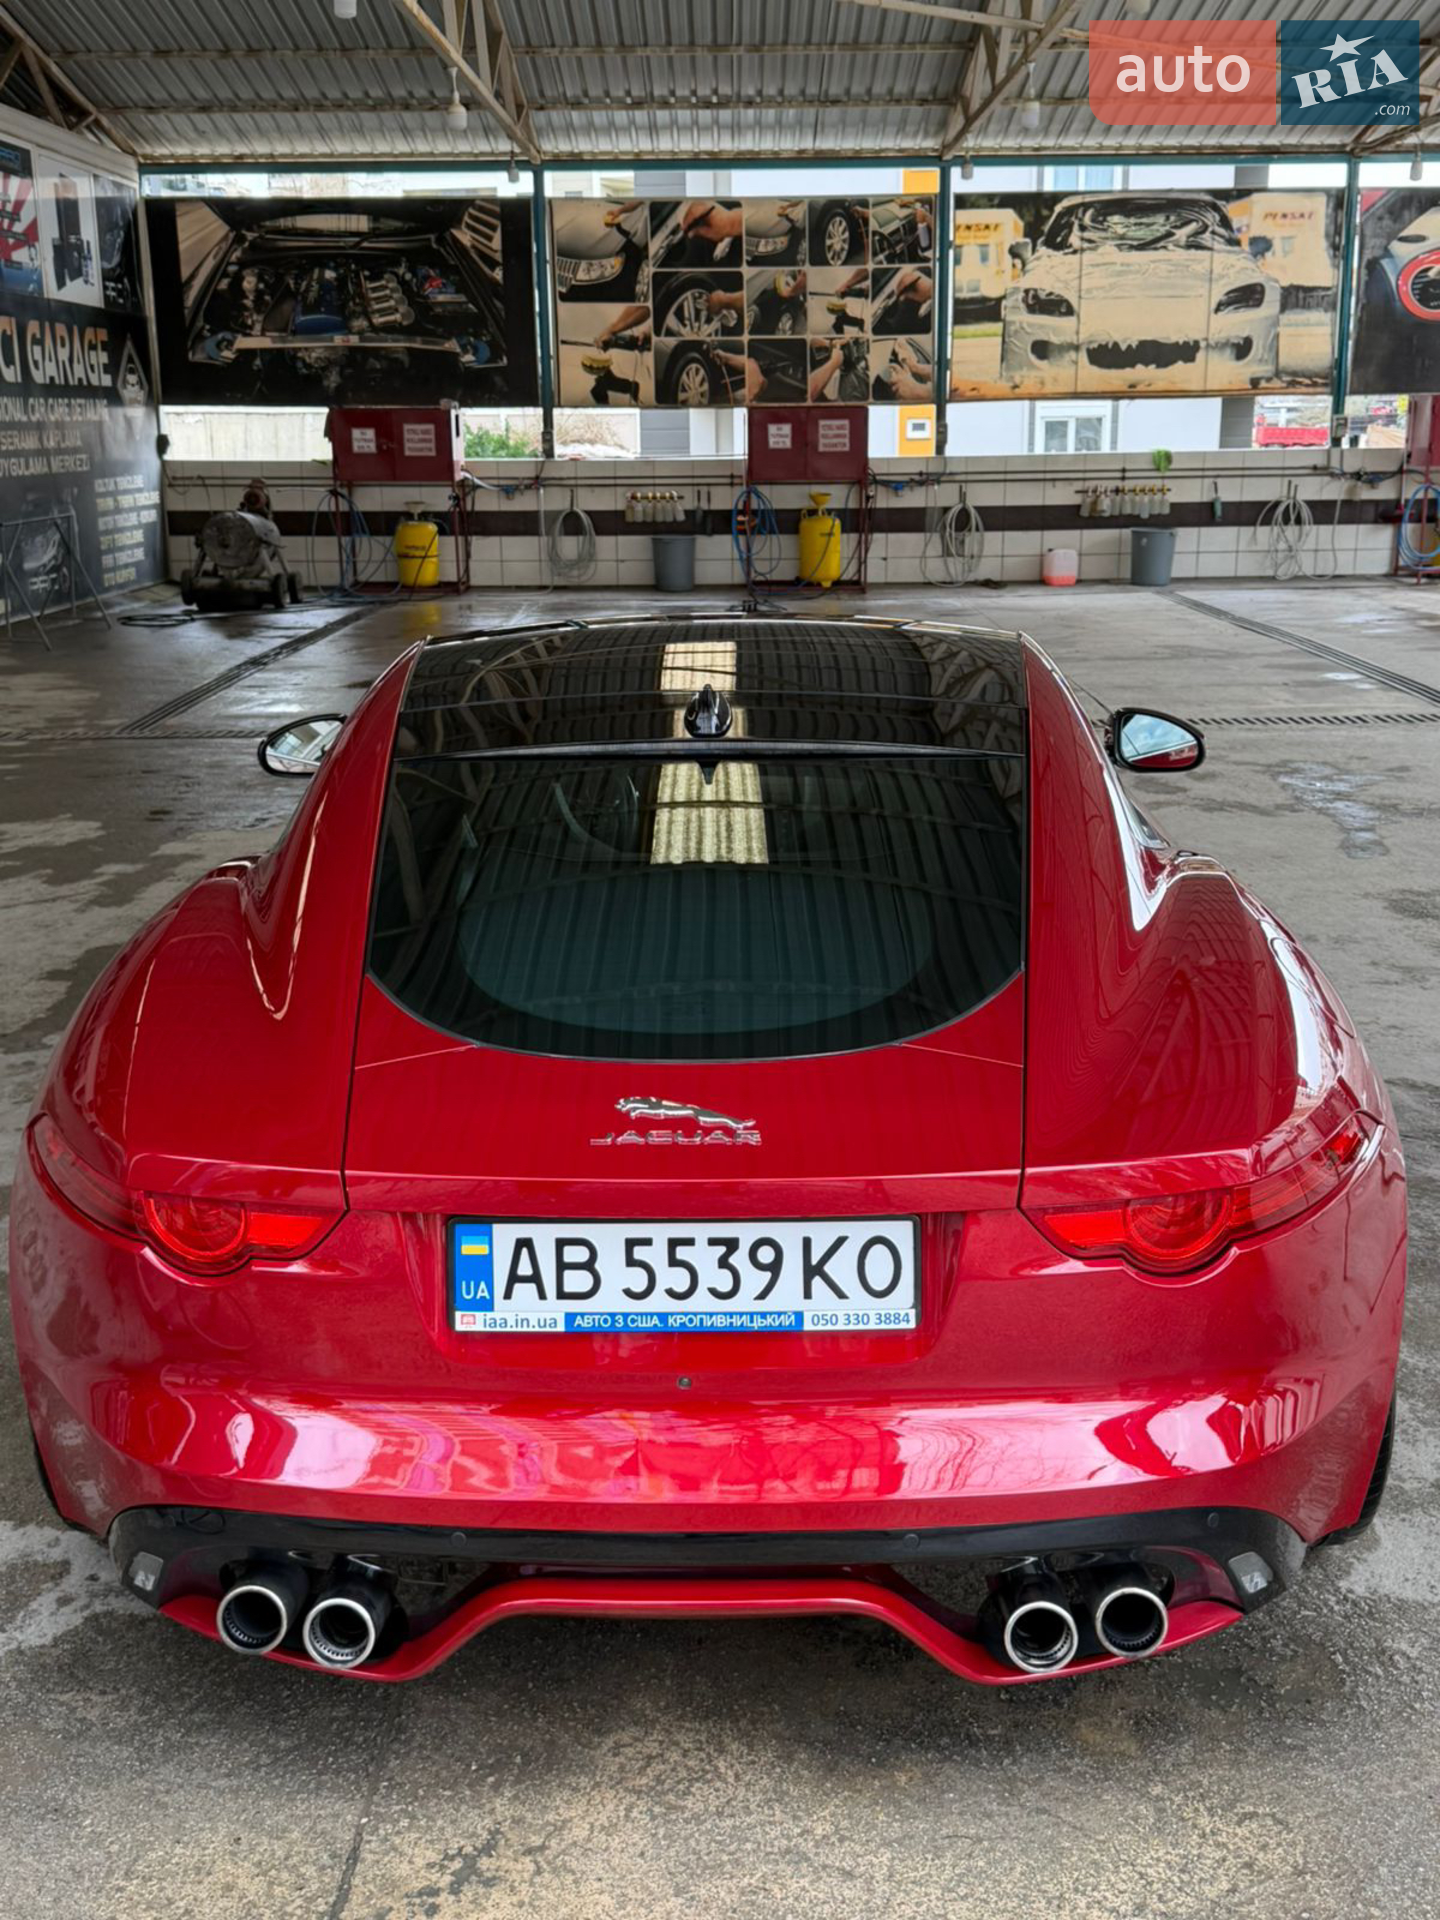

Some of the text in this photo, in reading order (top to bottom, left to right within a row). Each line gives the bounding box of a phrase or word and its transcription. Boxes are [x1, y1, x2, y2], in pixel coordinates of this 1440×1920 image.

[26, 320, 113, 387] GARAGE
[0, 396, 28, 422] IONAL
[28, 397, 47, 422] CAR
[48, 397, 71, 422] CARE
[42, 429, 83, 449] KAPLAMA
[590, 1130, 762, 1145] JAGUAR
[503, 1235, 903, 1301] AB 5539 KO
[461, 1280, 491, 1300] UA
[483, 1313, 558, 1329] iaa.in.ua
[573, 1314, 611, 1328] АВТО
[668, 1312, 795, 1330] КРОПИВНИЦЬКИЙ
[811, 1312, 911, 1327] 050 330 3884
